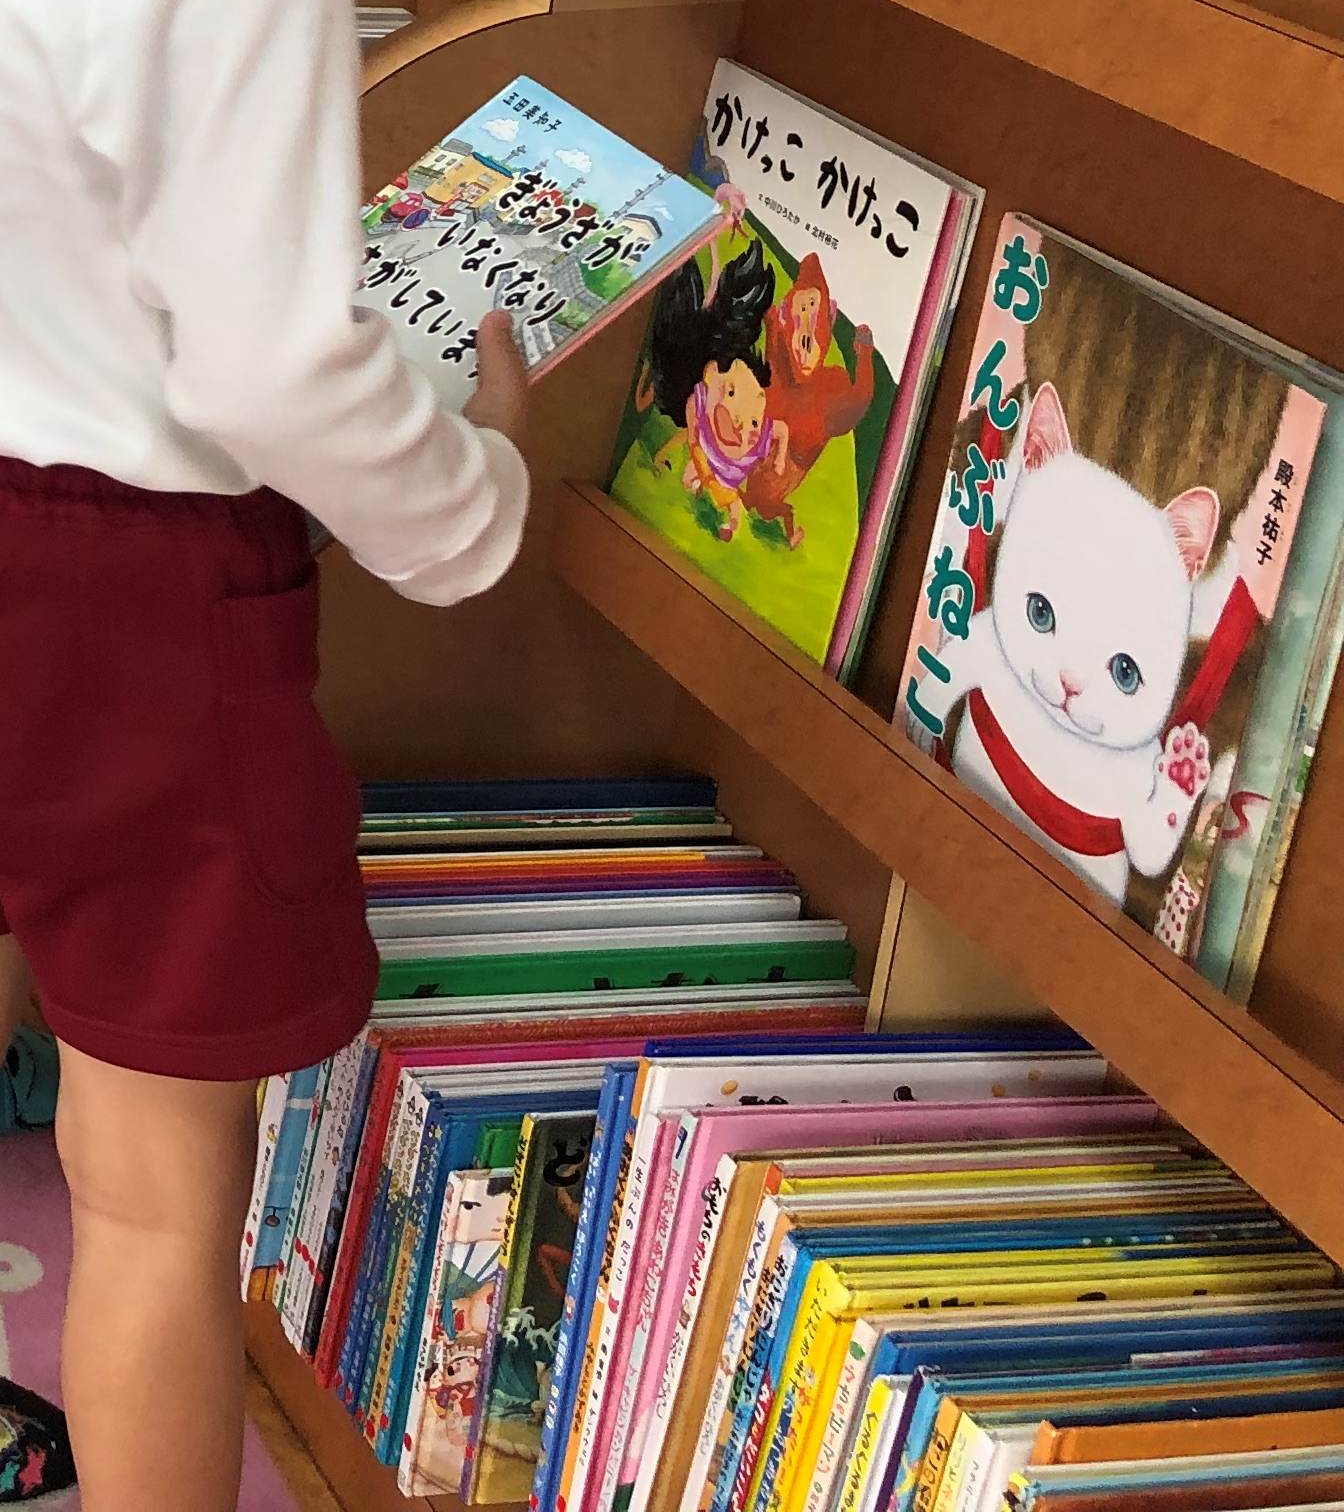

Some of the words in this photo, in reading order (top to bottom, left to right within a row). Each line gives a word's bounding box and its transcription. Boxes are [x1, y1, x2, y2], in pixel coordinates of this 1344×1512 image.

[498, 171, 651, 268] ぎょうざが
[711, 92, 805, 183] かけっこ
[817, 156, 921, 259] かけっこ
[438, 221, 568, 327] いなくなり
[905, 234, 1050, 739] おんぶねこ
